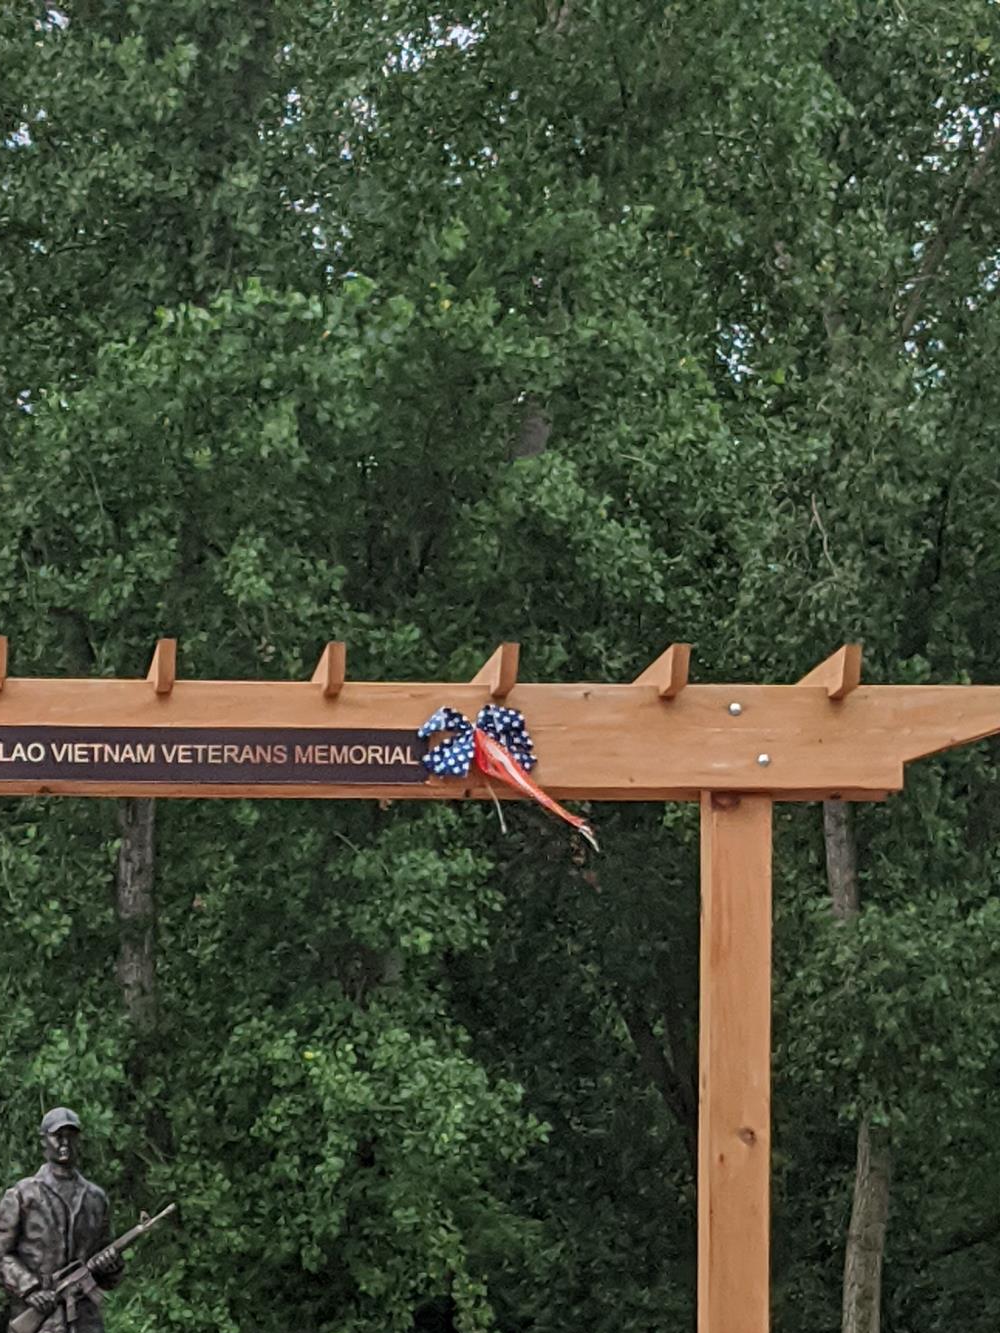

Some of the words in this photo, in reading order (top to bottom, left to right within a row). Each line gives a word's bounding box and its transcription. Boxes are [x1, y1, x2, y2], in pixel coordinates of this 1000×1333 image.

[51, 743, 155, 763] VIETNAM
[161, 744, 288, 764] VETERANS
[294, 745, 419, 765] MEMORIAL
